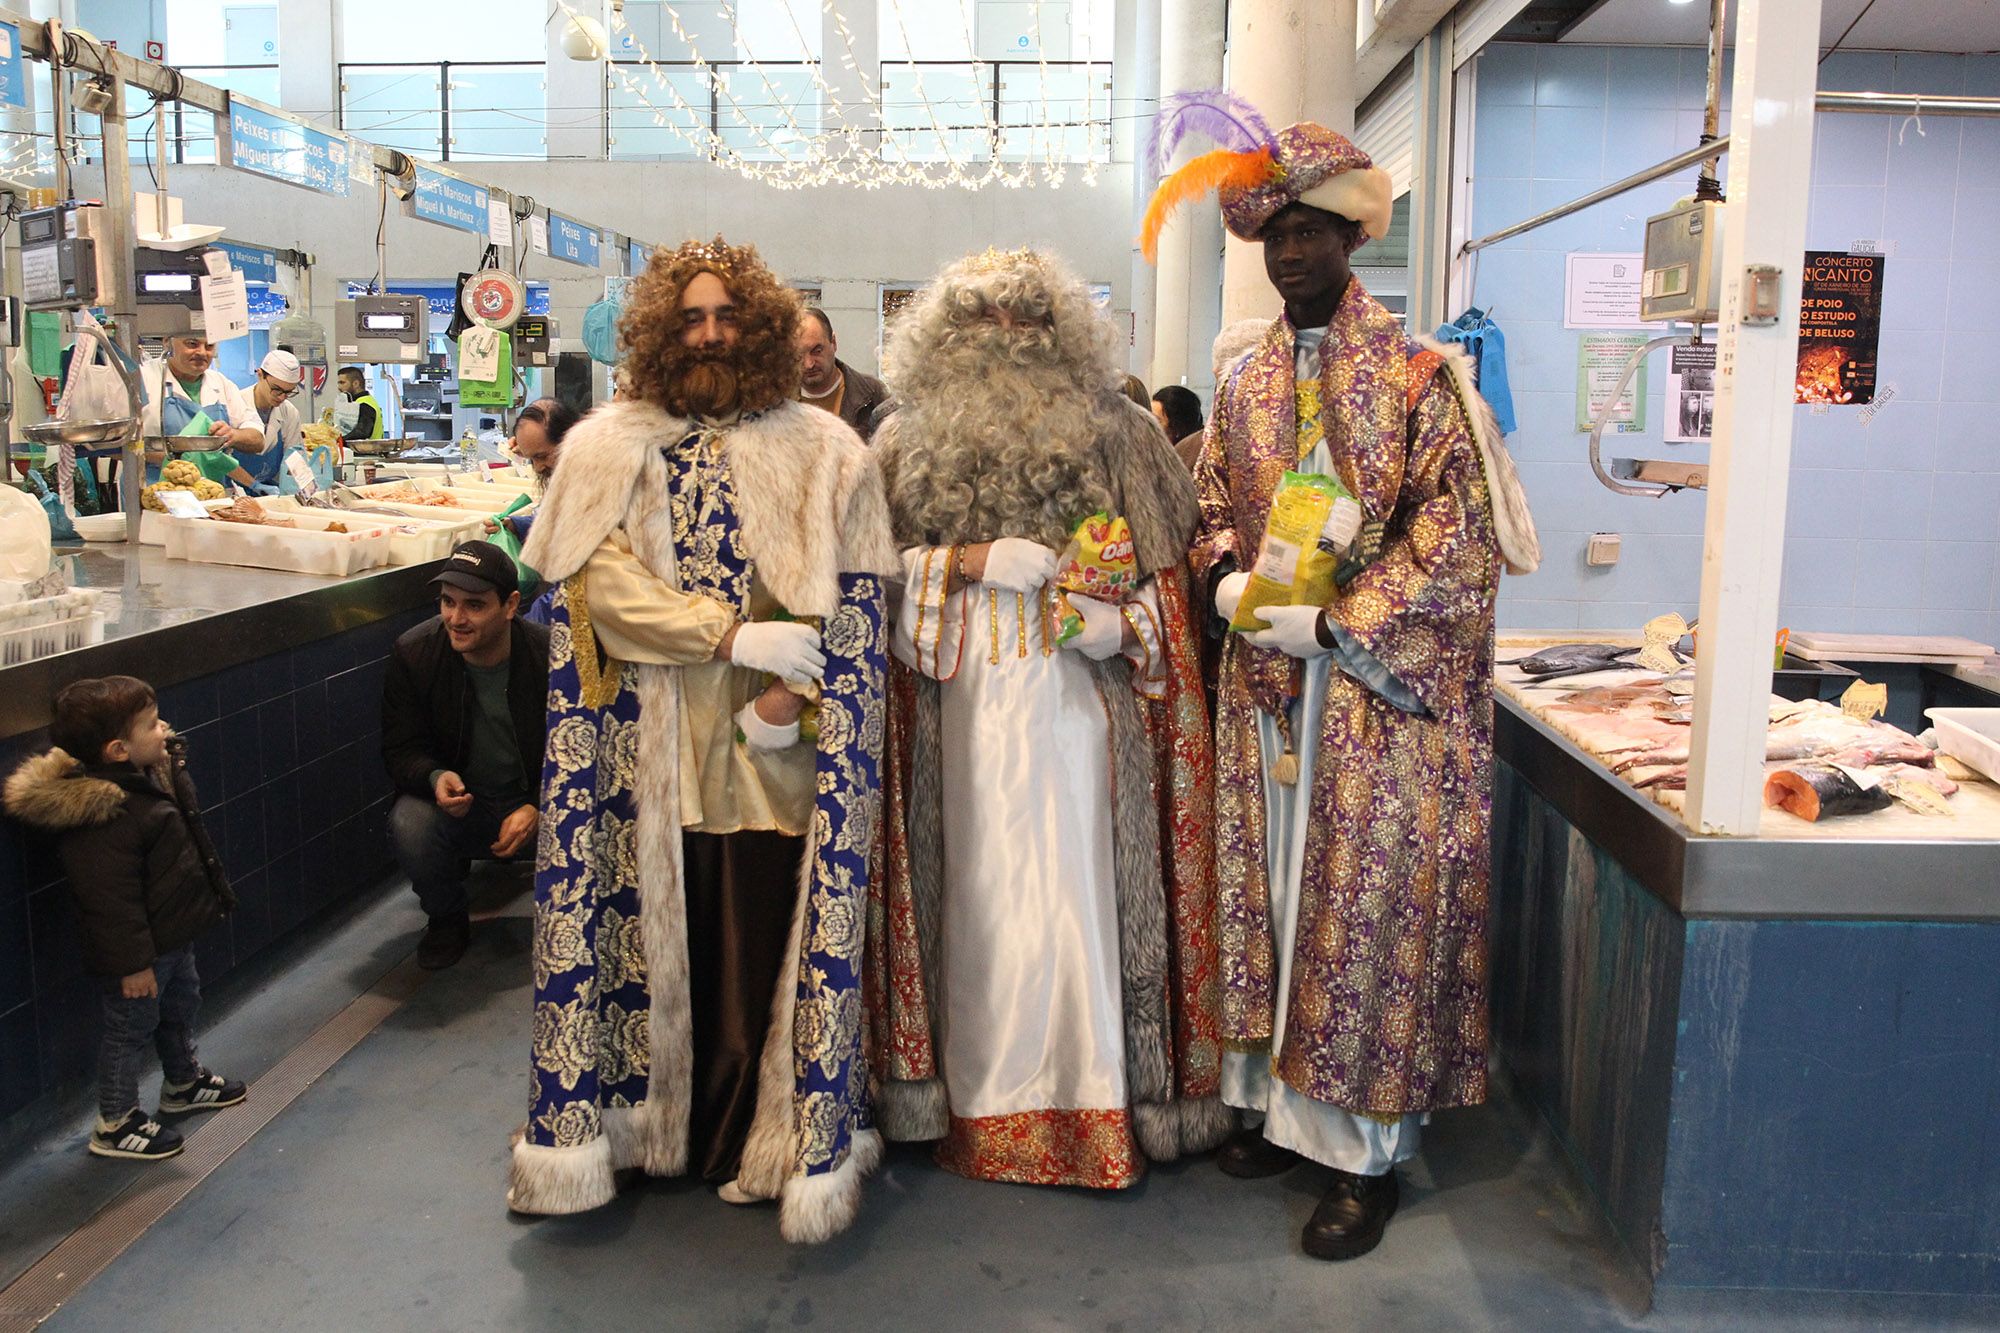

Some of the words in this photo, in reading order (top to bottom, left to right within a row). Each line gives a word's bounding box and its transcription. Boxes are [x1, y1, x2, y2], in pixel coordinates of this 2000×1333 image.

[234, 114, 270, 142] Peixes
[234, 140, 271, 166] Miguel
[443, 184, 472, 205] Mariscos
[416, 195, 438, 214] Miguel
[561, 221, 581, 241] Peixes
[236, 252, 261, 264] Mariscos
[566, 241, 578, 258] Lita
[1815, 257, 1873, 267] CONCERTO
[1800, 299, 1814, 307] DE
[1816, 299, 1843, 308] POIO
[1811, 311, 1856, 321] ESTUDIO
[1799, 328, 1812, 337] DE
[1814, 328, 1855, 338] BELUSO
